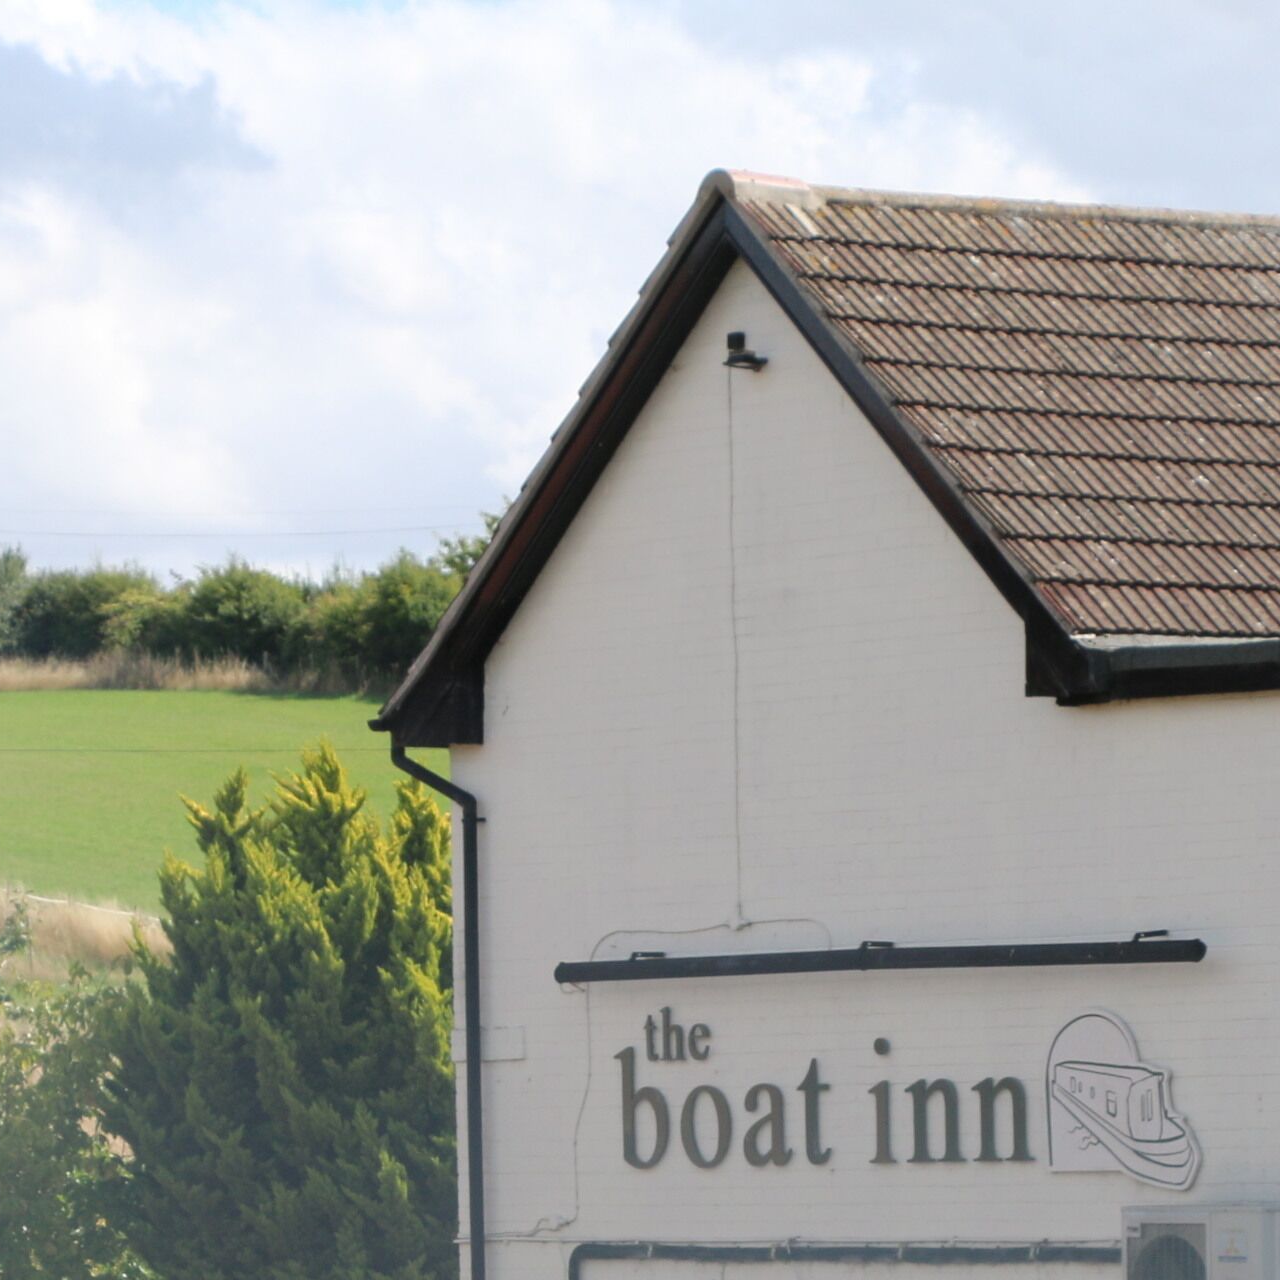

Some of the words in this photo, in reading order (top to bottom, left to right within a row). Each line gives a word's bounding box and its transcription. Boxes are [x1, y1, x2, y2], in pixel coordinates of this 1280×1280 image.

[643, 1007, 712, 1062] the
[614, 1046, 832, 1170] boat
[866, 1037, 1036, 1165] inn
